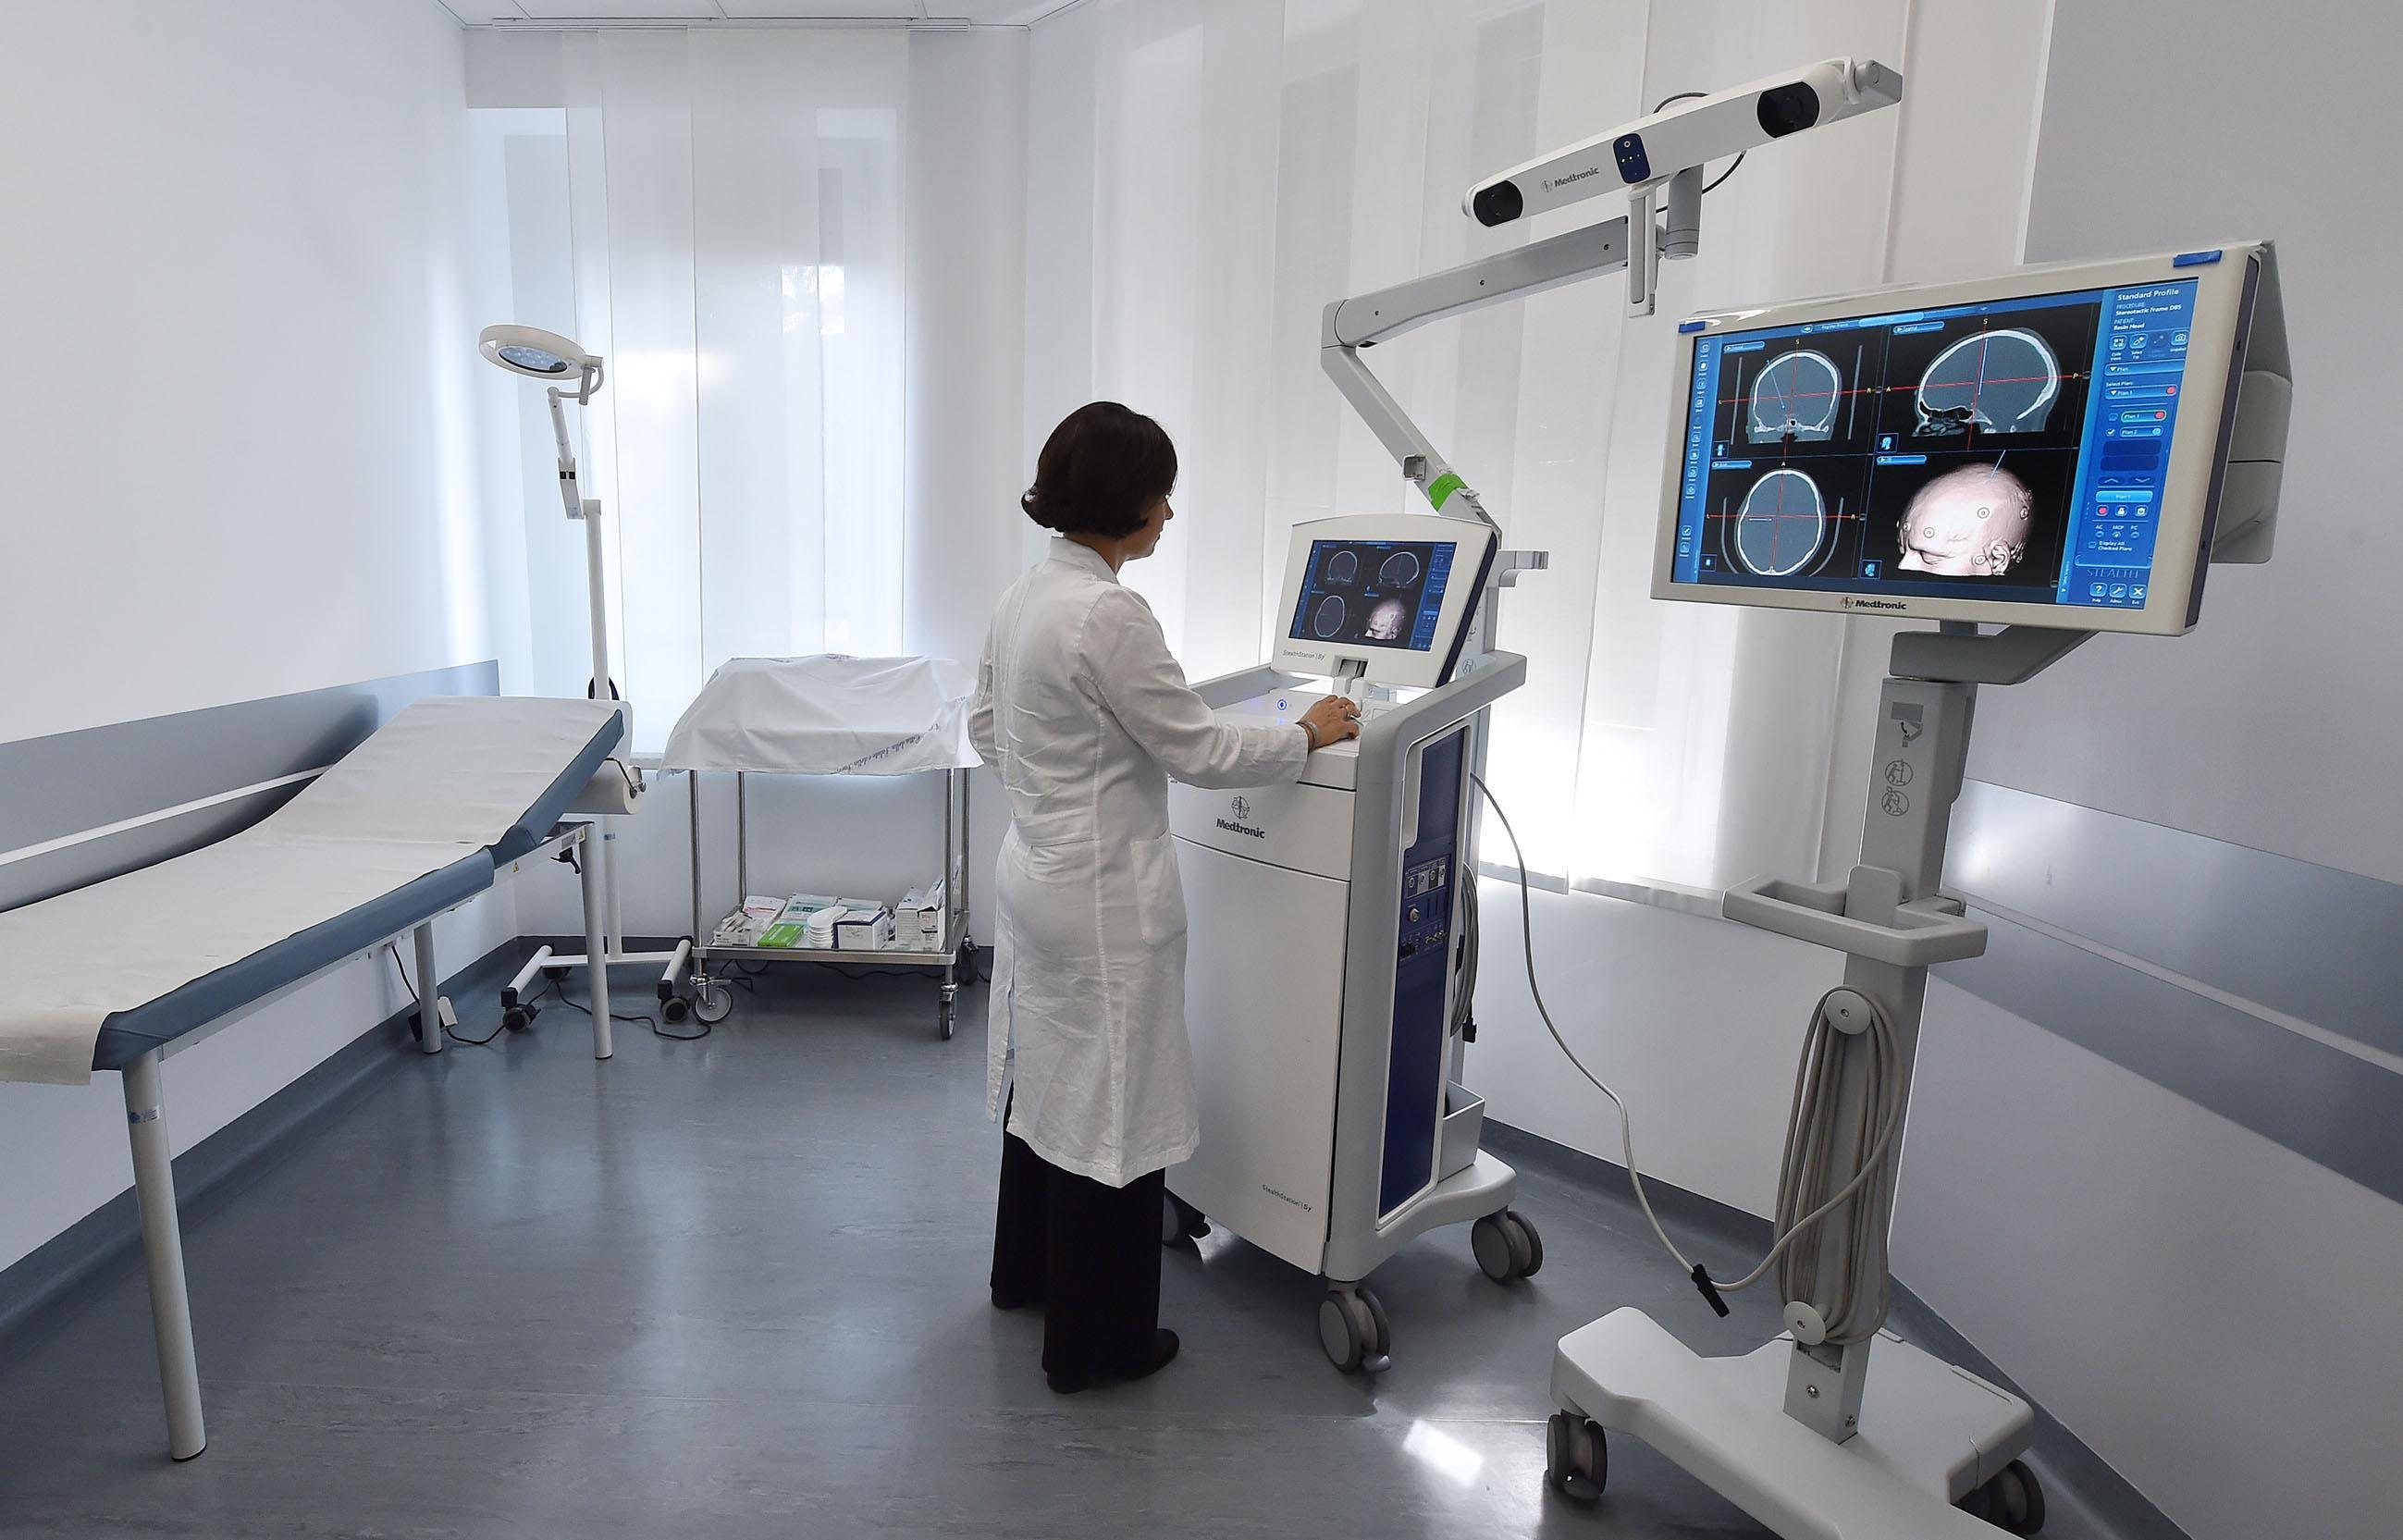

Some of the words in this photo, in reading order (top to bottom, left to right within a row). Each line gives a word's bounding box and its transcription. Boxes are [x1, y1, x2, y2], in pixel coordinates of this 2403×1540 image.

[1554, 167, 1599, 188] Medtronic
[2117, 291, 2152, 302] Standard
[2153, 289, 2179, 297] Profile
[2115, 308, 2149, 316] Stereotactic
[2087, 569, 2138, 579] STEALTH
[1855, 600, 1907, 610] Medtronic
[1216, 818, 1265, 839] Medtronic
